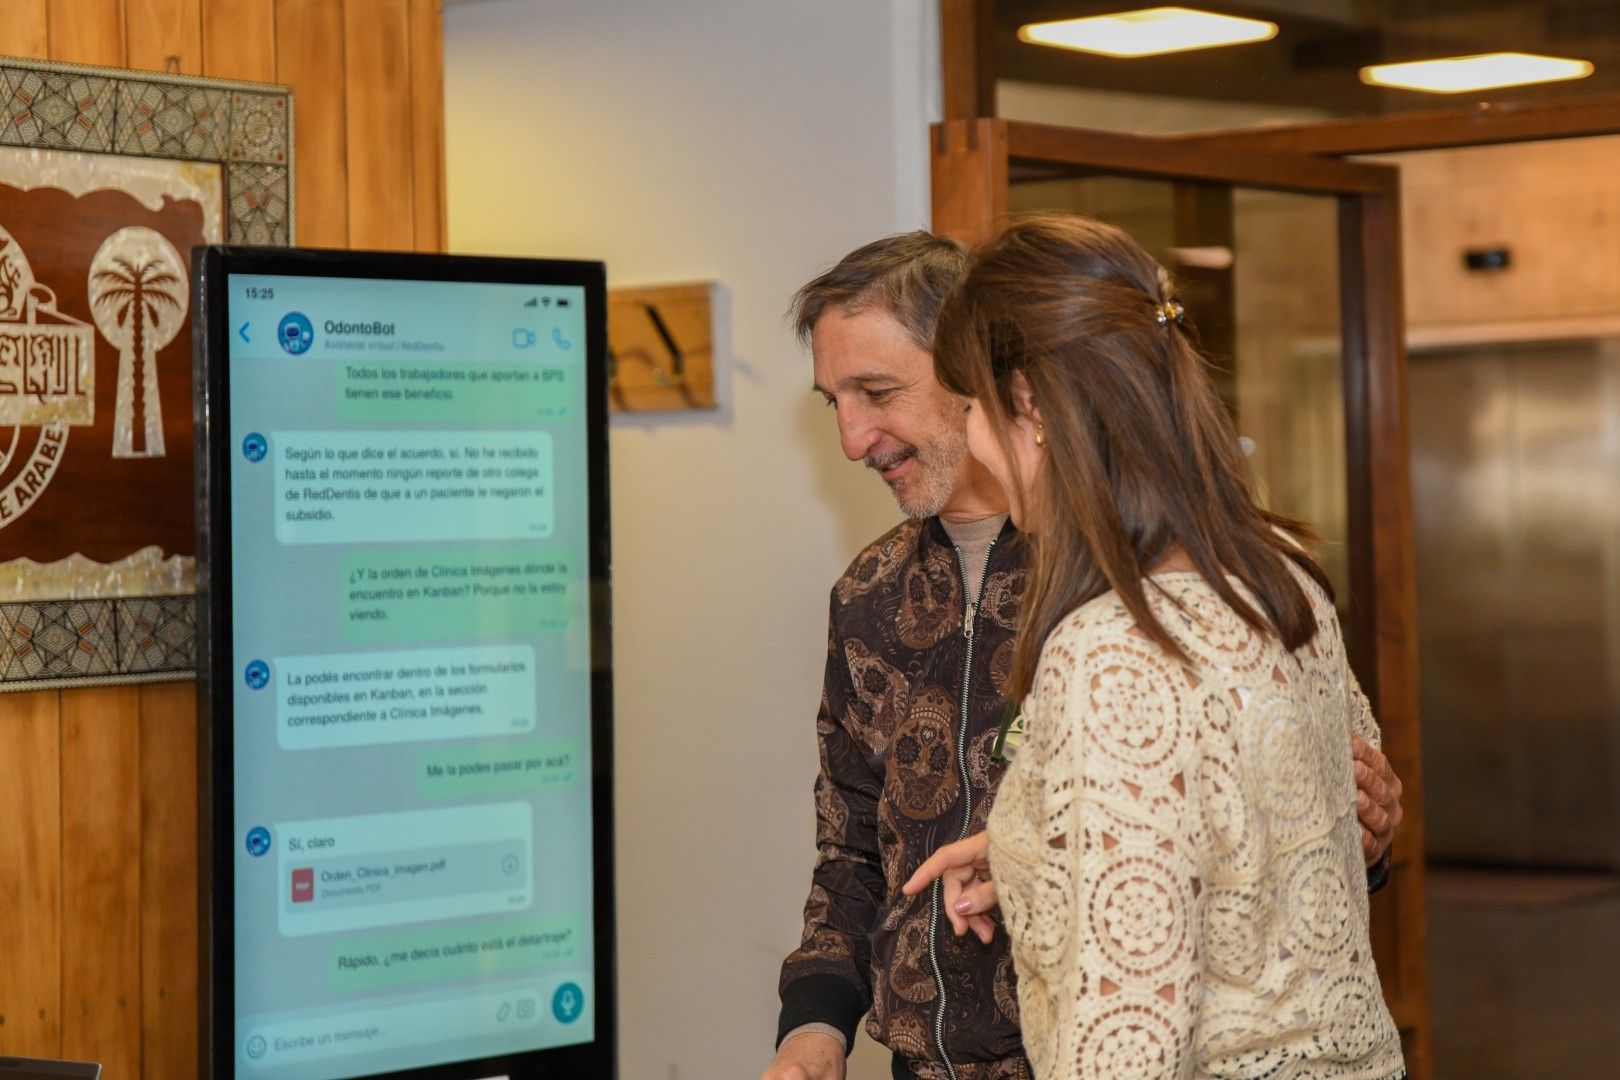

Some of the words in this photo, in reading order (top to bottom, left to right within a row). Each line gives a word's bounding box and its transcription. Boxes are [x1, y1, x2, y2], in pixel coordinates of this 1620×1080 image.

[245, 287, 274, 300] 15:25
[324, 320, 396, 336] OdontoBot
[345, 366, 378, 380] Todos
[381, 367, 397, 380] los
[400, 368, 465, 383] trabajadores
[468, 371, 488, 383] que
[491, 370, 529, 384] aportan
[532, 373, 539, 382] a
[345, 388, 378, 400] tienen
[382, 390, 401, 400] ese
[285, 447, 321, 464] Según
[324, 447, 335, 459] lo
[338, 449, 358, 462] que
[361, 448, 384, 460] dice
[387, 447, 397, 459] el
[464, 446, 479, 458] No
[482, 447, 495, 458] he
[498, 446, 538, 458] recibido
[14, 428, 63, 507] ARABE
[285, 468, 316, 480] hasta
[319, 468, 329, 480] el
[332, 467, 384, 480] momento
[425, 468, 463, 481] reporte
[466, 467, 479, 479] de
[285, 488, 299, 500] de
[303, 487, 360, 500] RedDentis
[363, 488, 378, 500] de
[381, 489, 401, 502] que
[404, 490, 411, 499] a
[414, 488, 428, 499] un
[430, 487, 475, 501] paciente
[490, 487, 532, 502] negaron
[285, 508, 334, 521] subsidio.
[349, 566, 365, 584] ¿Y
[367, 567, 378, 579] la
[381, 567, 412, 579] orden
[415, 566, 428, 578] de
[349, 588, 403, 600] encuentro
[406, 588, 420, 600] en
[423, 583, 470, 598] Kanban?
[512, 584, 526, 595] no
[349, 608, 388, 621] viendo.
[286, 671, 301, 686] La
[342, 668, 394, 682] encontrar
[397, 666, 432, 679] dentro
[434, 666, 447, 677] de
[450, 663, 465, 676] los
[468, 662, 525, 676] formularios
[286, 691, 350, 708] disponibles
[353, 691, 367, 703] en
[418, 687, 432, 698] en
[434, 685, 445, 697] la
[286, 709, 377, 728] correspondiente
[380, 711, 387, 721] a
[427, 764, 443, 777] Me
[446, 763, 457, 776] la
[494, 759, 522, 775] pasar
[525, 758, 541, 773] por
[307, 836, 336, 850] claro
[274, 1034, 315, 1051] Escribe
[317, 1031, 332, 1045] un
